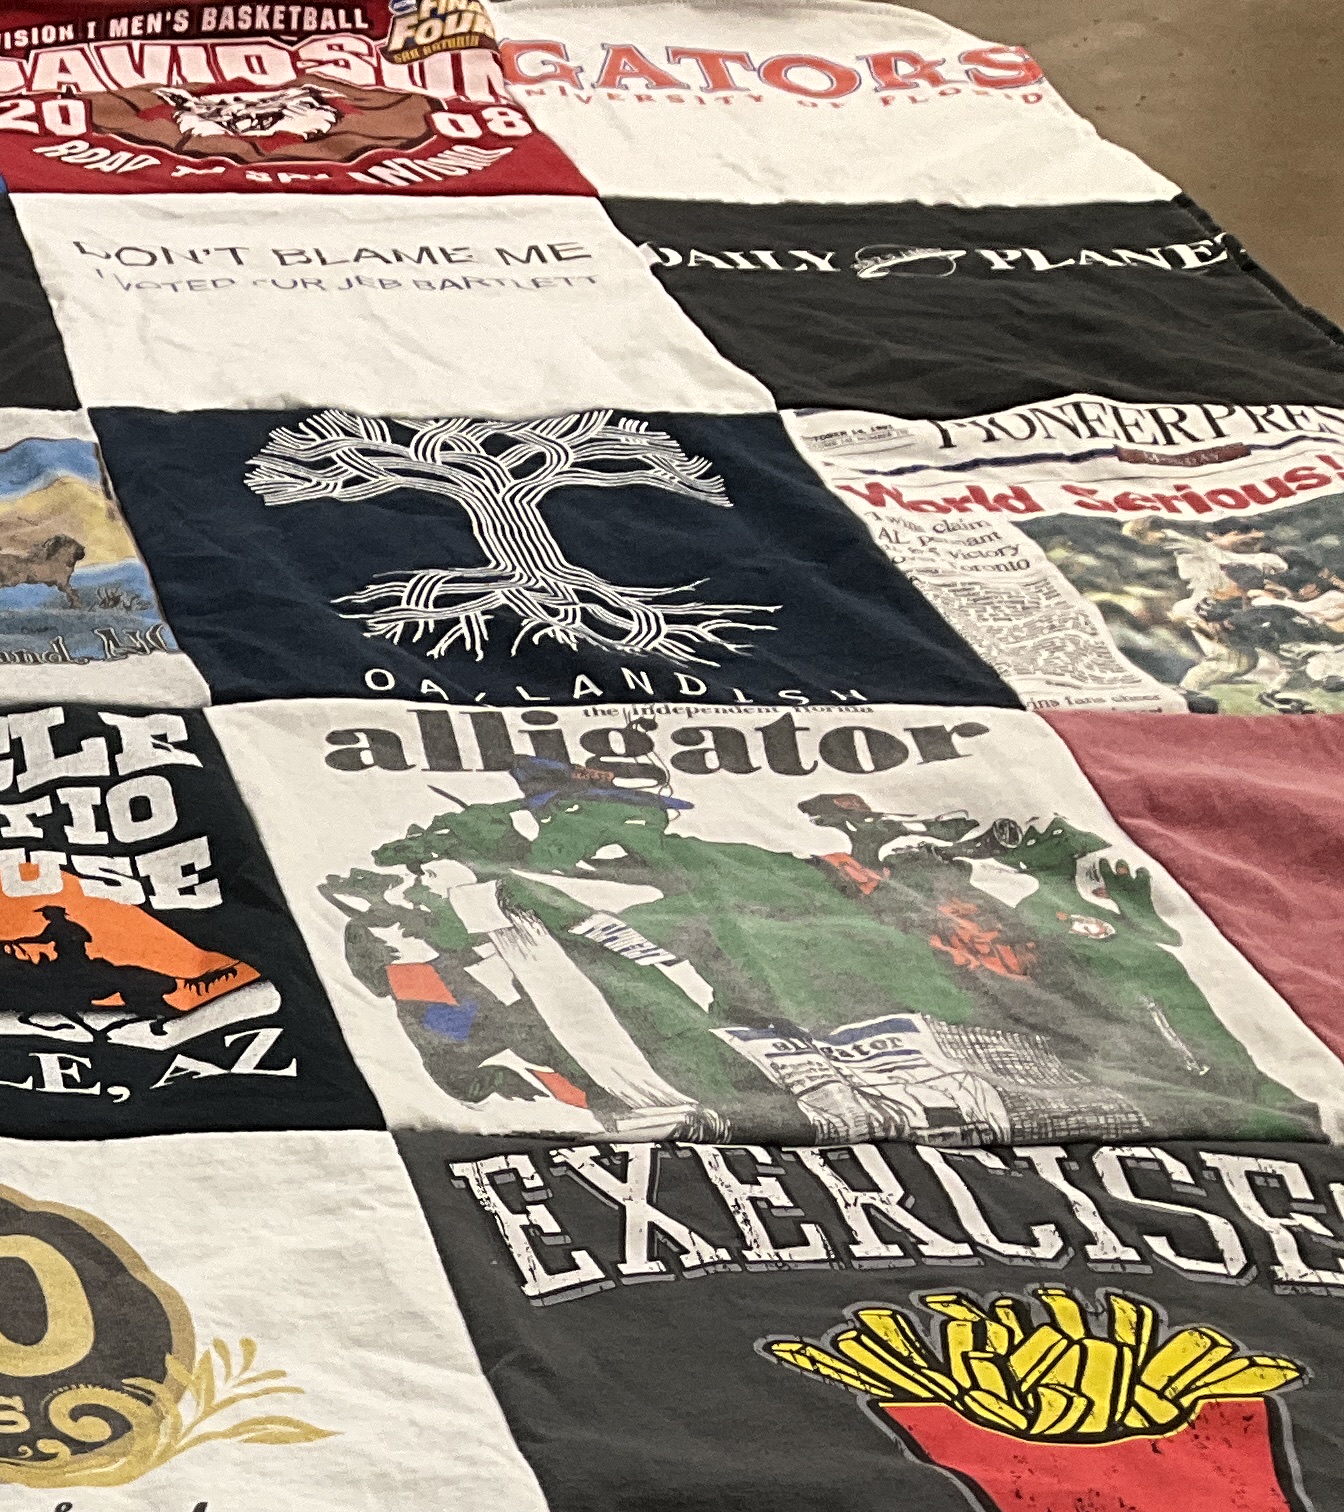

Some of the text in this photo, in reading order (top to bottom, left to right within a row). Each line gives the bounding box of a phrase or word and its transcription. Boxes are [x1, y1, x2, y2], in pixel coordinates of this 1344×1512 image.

[109, 9, 190, 38] MEN'S
[201, 3, 370, 33] BASKETBALL
[388, 10, 495, 51] FOUR
[499, 38, 1045, 101] GATORS
[434, 106, 533, 140] 08
[32, 139, 164, 177] ROAD
[271, 245, 475, 267] BLAME
[495, 241, 592, 267] ME
[836, 482, 1046, 515] World
[1061, 454, 1344, 514] Serious!
[948, 543, 1020, 560] victory
[324, 708, 992, 787] alligator
[149, 1027, 300, 1092] AZ
